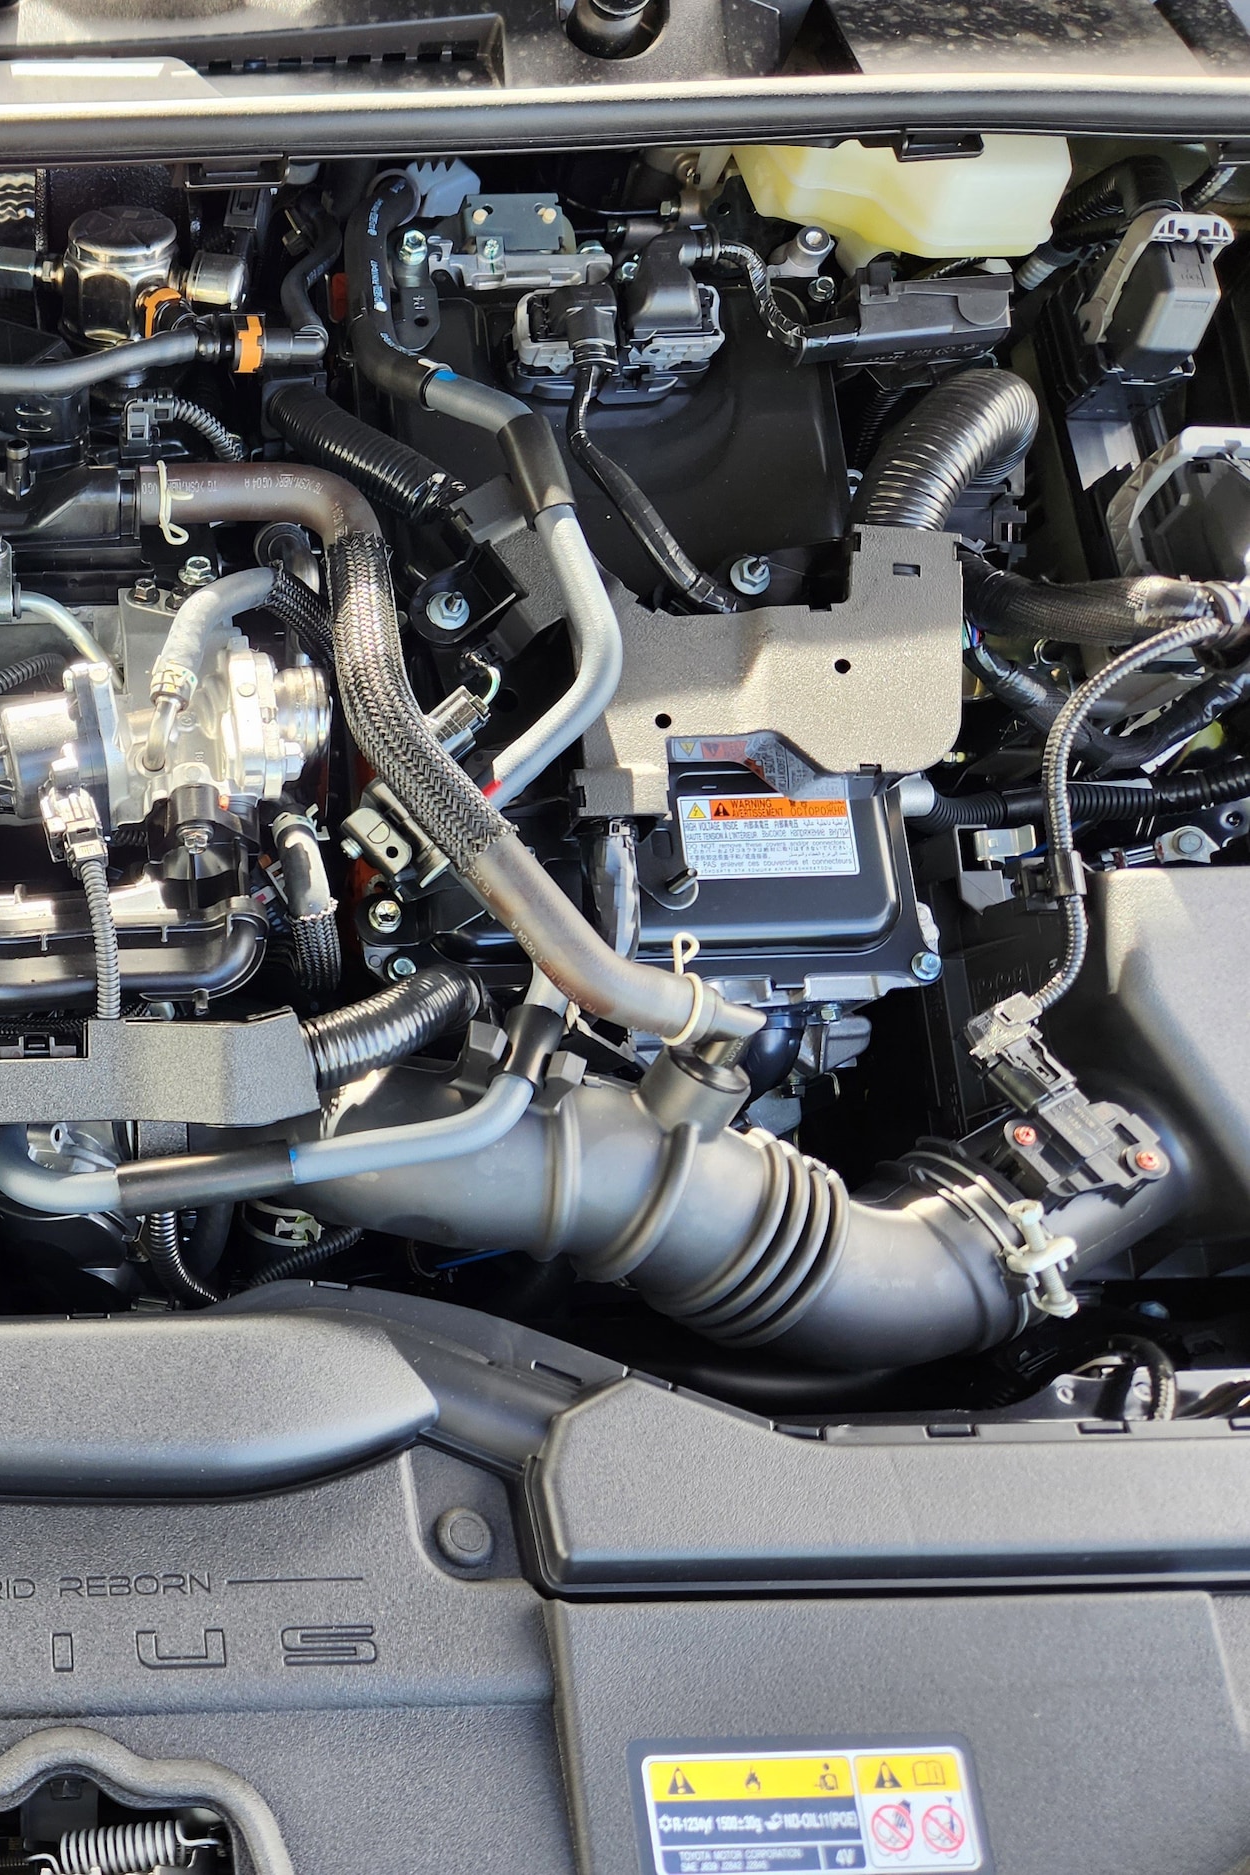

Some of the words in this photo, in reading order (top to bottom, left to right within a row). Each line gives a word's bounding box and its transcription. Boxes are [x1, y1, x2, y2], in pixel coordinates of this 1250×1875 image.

[731, 798, 772, 809] WARNING
[731, 807, 784, 819] AVERTISSEMENT
[59, 1571, 213, 1598] REBORN
[678, 1850, 712, 1862] TOYOTA
[713, 1849, 745, 1861] MOTOR
[745, 1847, 805, 1860] CORPORATION
[680, 1861, 699, 1873] SAE
